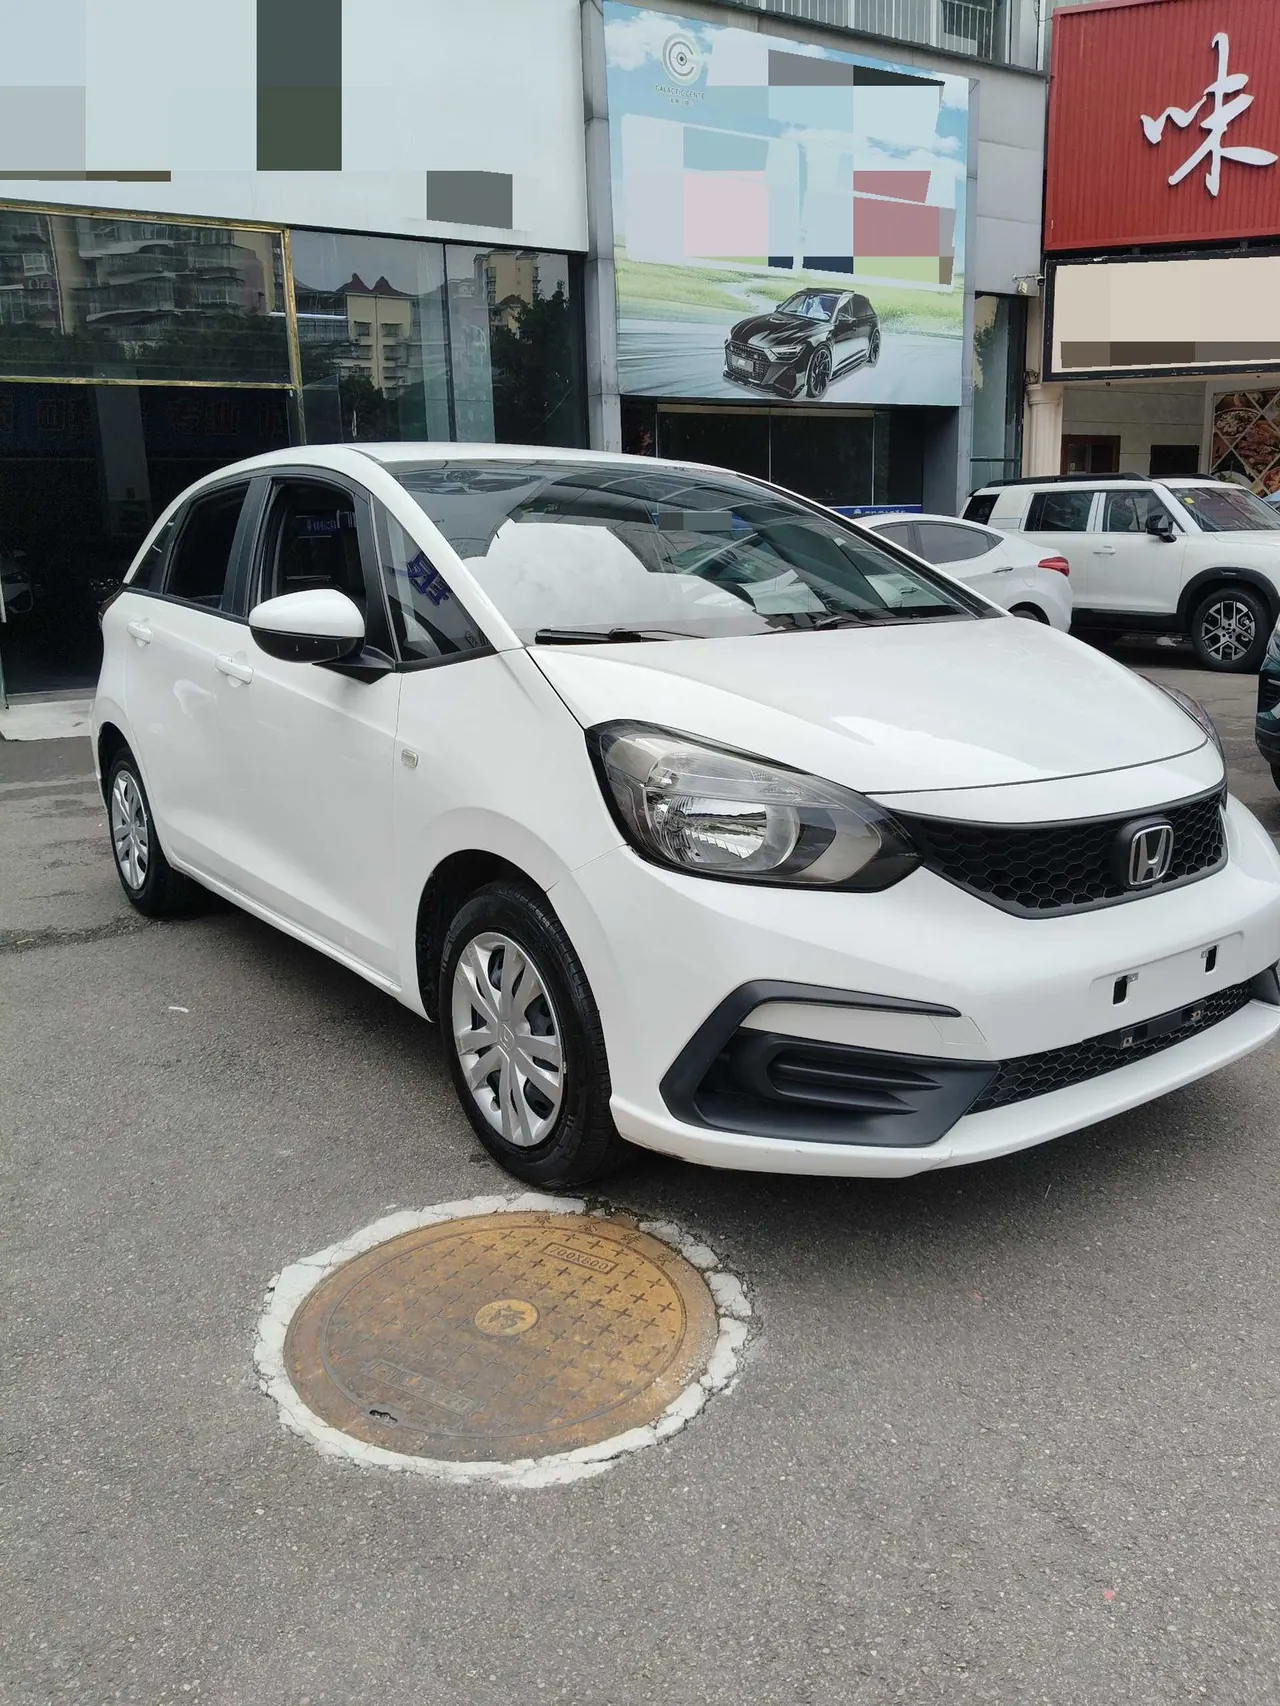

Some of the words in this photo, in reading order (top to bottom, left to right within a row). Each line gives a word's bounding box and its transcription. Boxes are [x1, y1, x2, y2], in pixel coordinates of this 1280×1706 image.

[686, 90, 705, 100] CENTE
[1140, 32, 1279, 197] 味
[549, 1245, 609, 1270] 700X800
